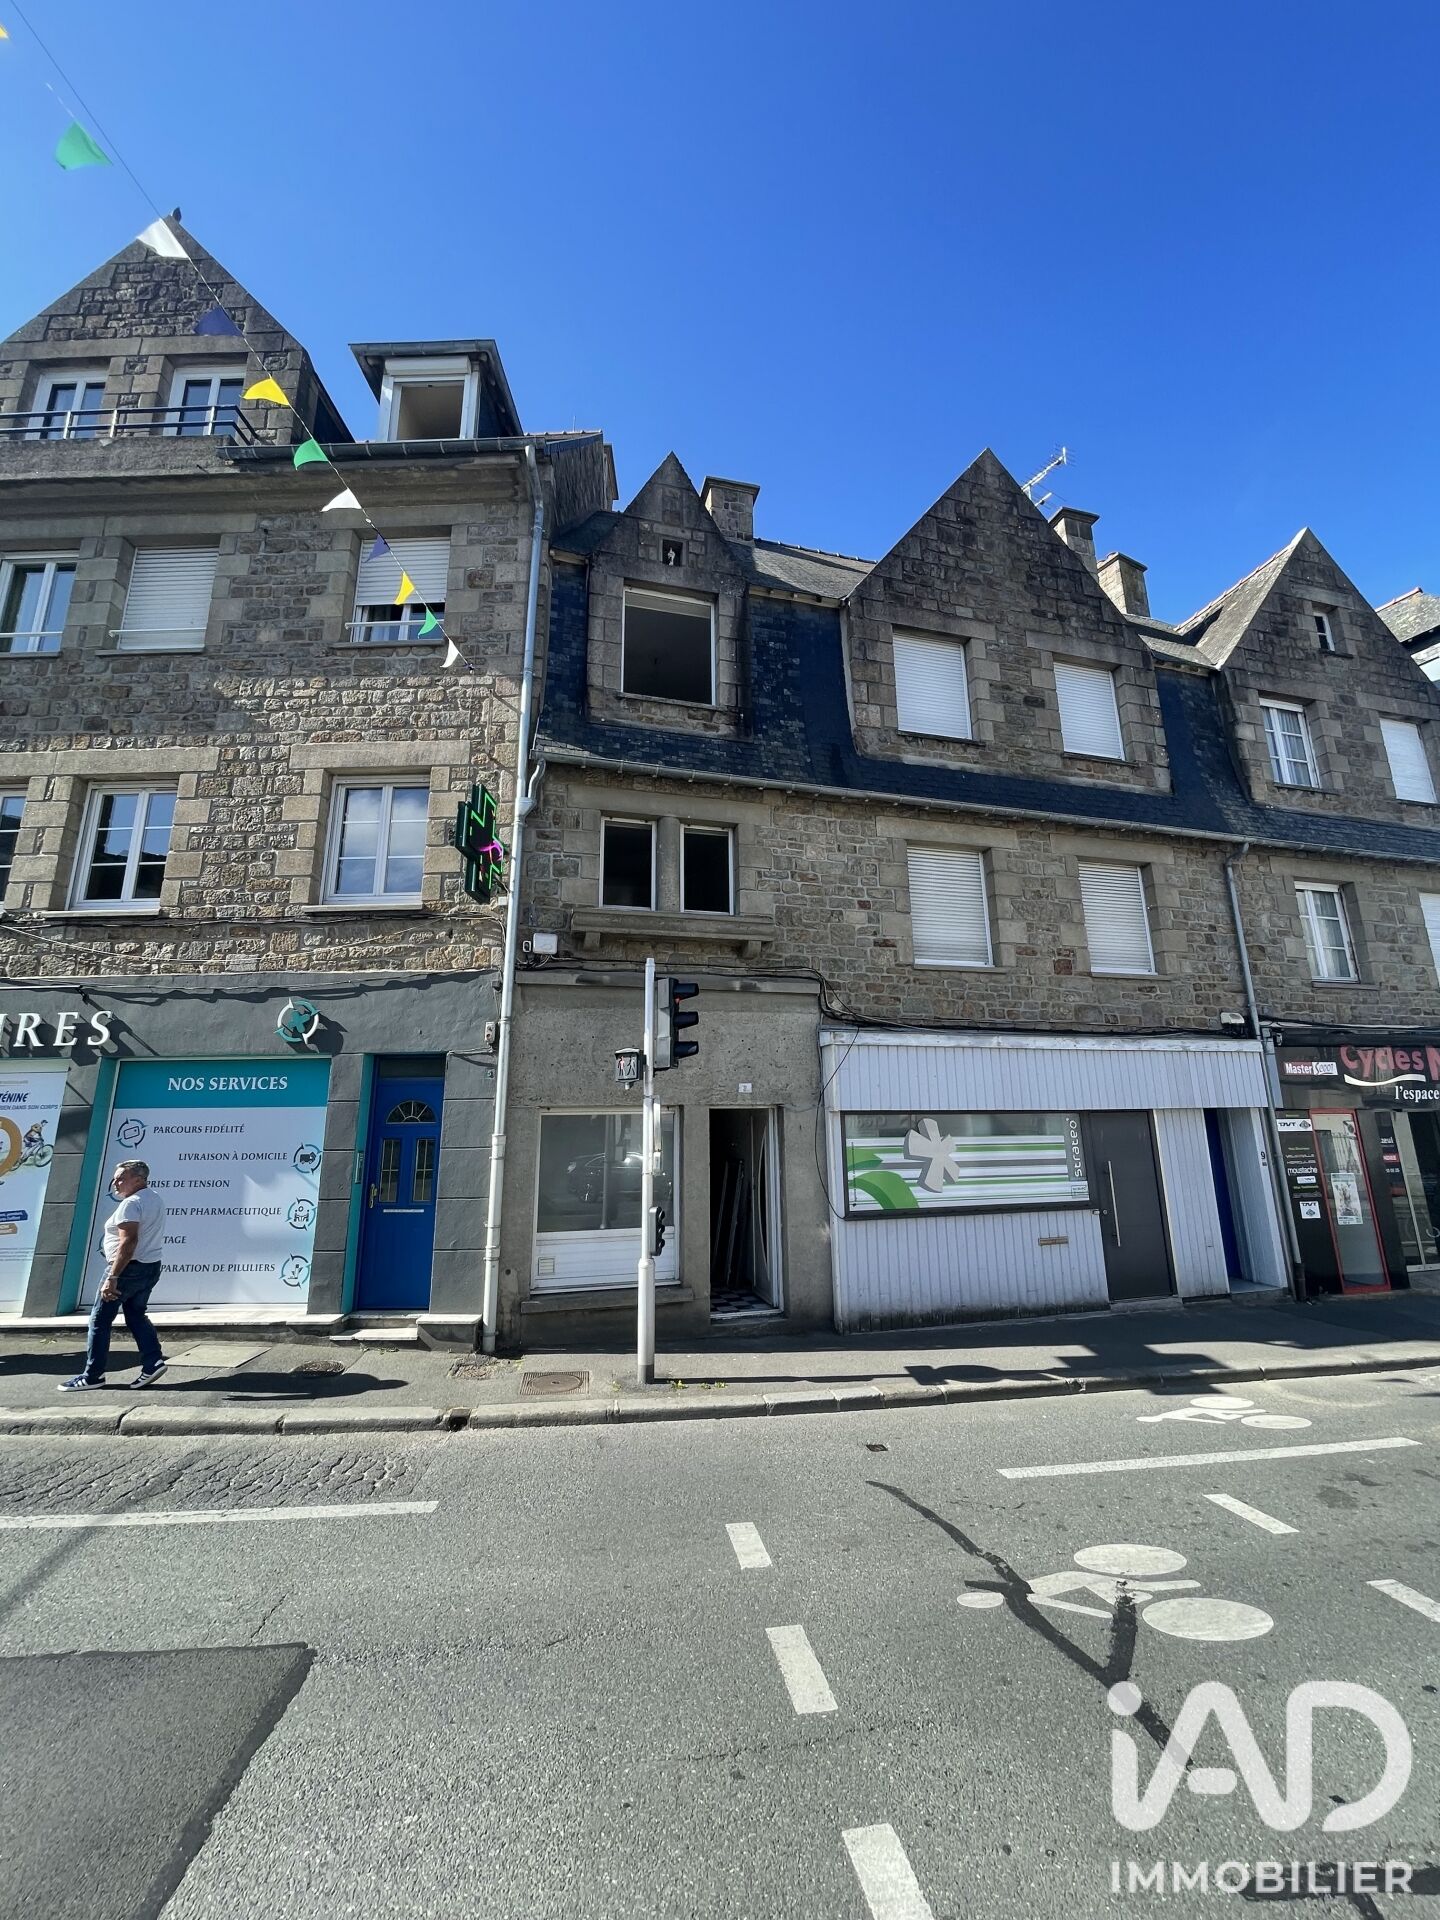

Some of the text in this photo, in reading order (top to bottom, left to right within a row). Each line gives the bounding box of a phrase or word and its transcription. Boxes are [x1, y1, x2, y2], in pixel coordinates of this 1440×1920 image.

[1340, 1045, 1425, 1078] Cycles
[167, 1076, 288, 1091] NOS SERVICES
[1394, 1086, 1440, 1102] l'espace
[153, 1122, 245, 1134] PARCOURS FIDÉLITÉ
[178, 1149, 288, 1161] LIVRAISON À DOMICILE
[1260, 1151, 1266, 1160] 9
[173, 1179, 186, 1188] DE
[187, 1179, 230, 1188] TENSION
[189, 1206, 282, 1216] PHARMACEUTIQUE
[212, 1263, 225, 1272] DE
[227, 1262, 275, 1272] PILULIERS
